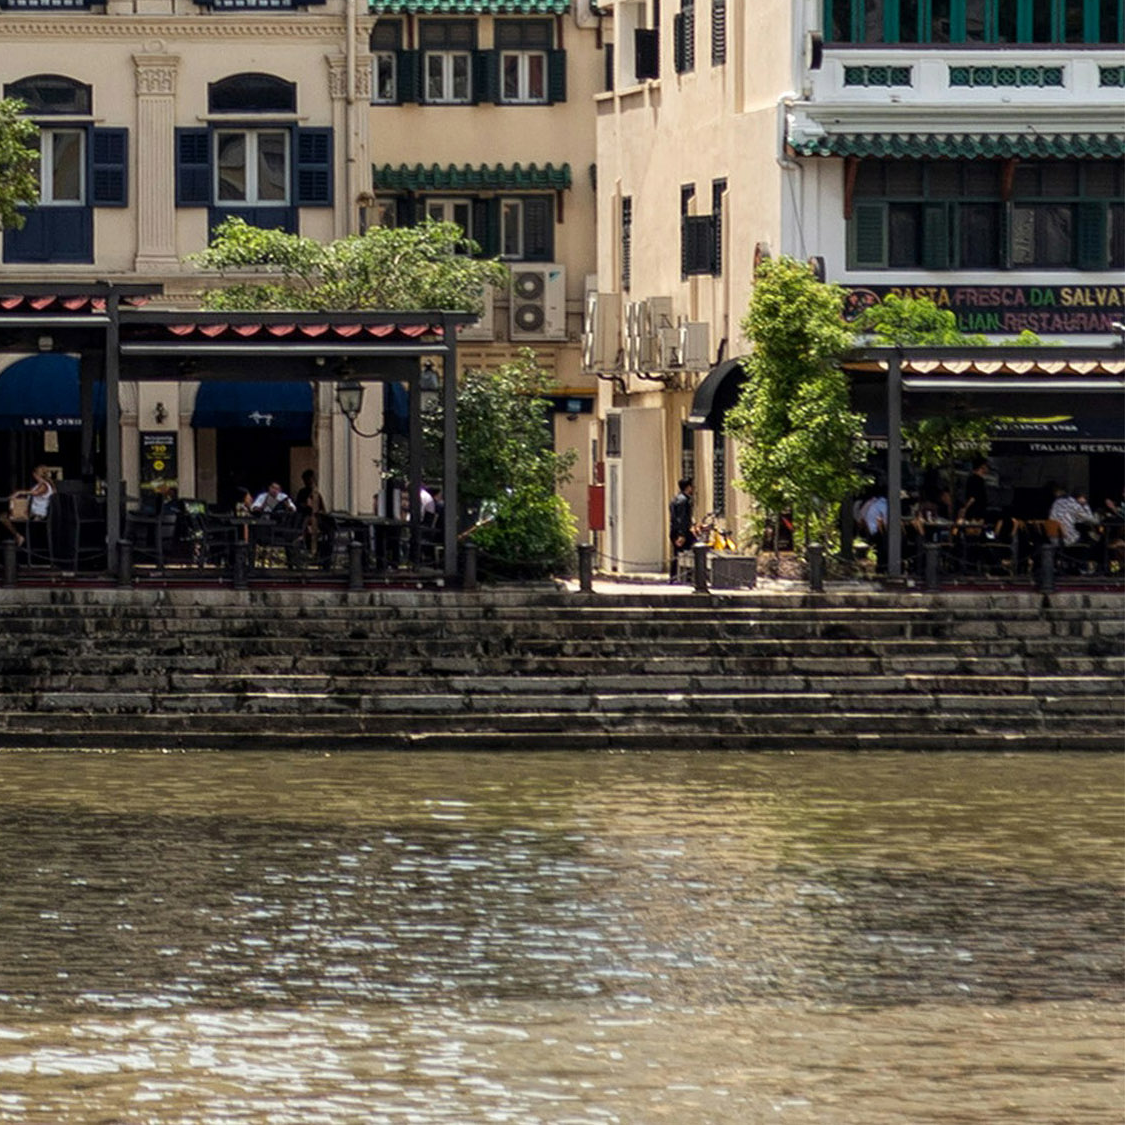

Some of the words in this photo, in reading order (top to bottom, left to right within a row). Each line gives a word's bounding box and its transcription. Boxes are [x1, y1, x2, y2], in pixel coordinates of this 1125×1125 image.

[891, 287, 951, 306] PASTA
[955, 287, 1026, 306] FRESCA
[1030, 287, 1054, 306] DA
[1004, 312, 1124, 331] RESTAURANT
[1029, 443, 1077, 451] ITALIAN
